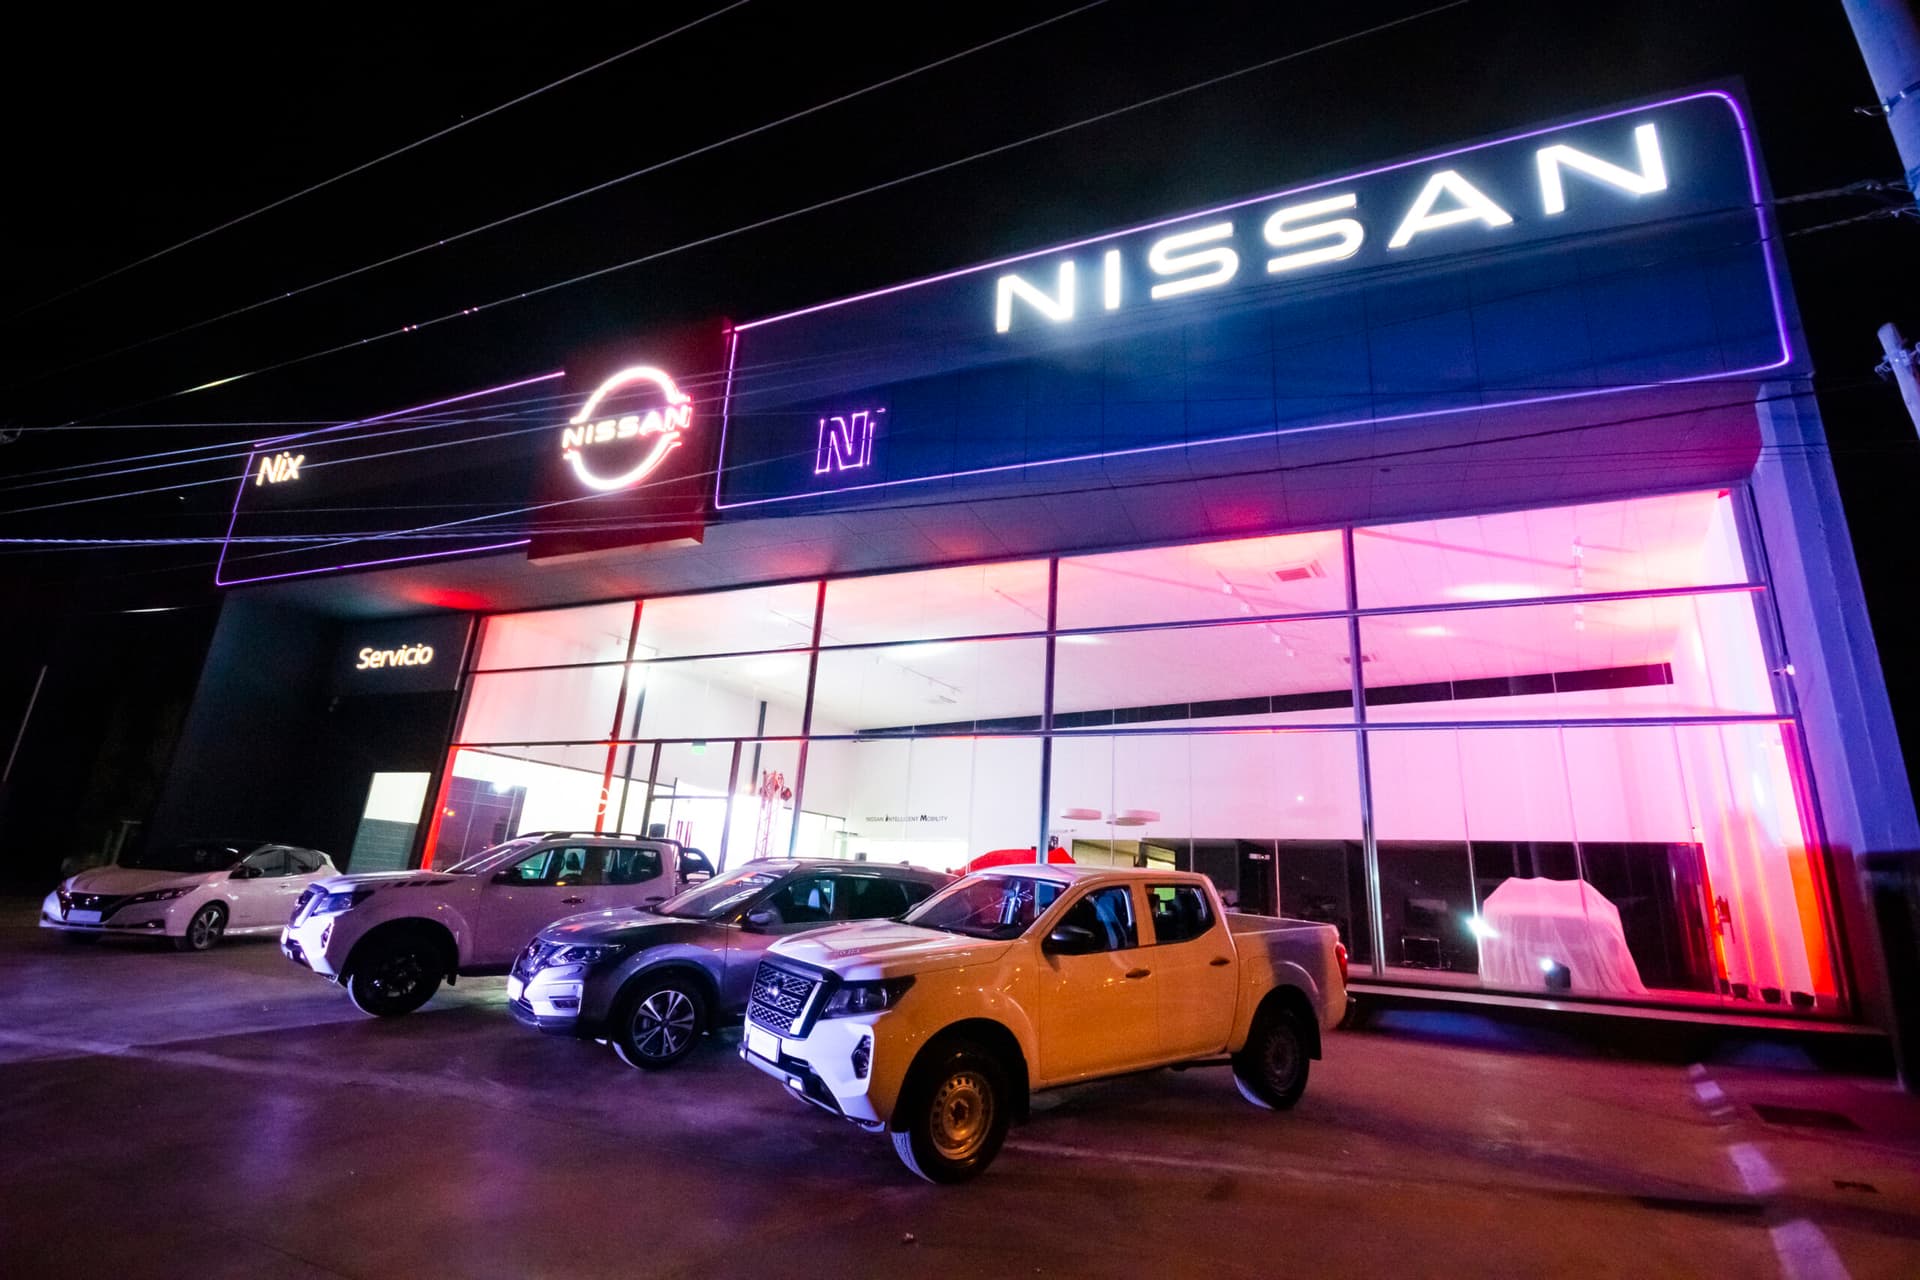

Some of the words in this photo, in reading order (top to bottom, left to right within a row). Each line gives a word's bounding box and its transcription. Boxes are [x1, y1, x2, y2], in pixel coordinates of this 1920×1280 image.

[995, 122, 1668, 333] NISSAN
[561, 403, 693, 450] NISSAN
[256, 451, 306, 487] Nix
[356, 643, 434, 670] Servicio
